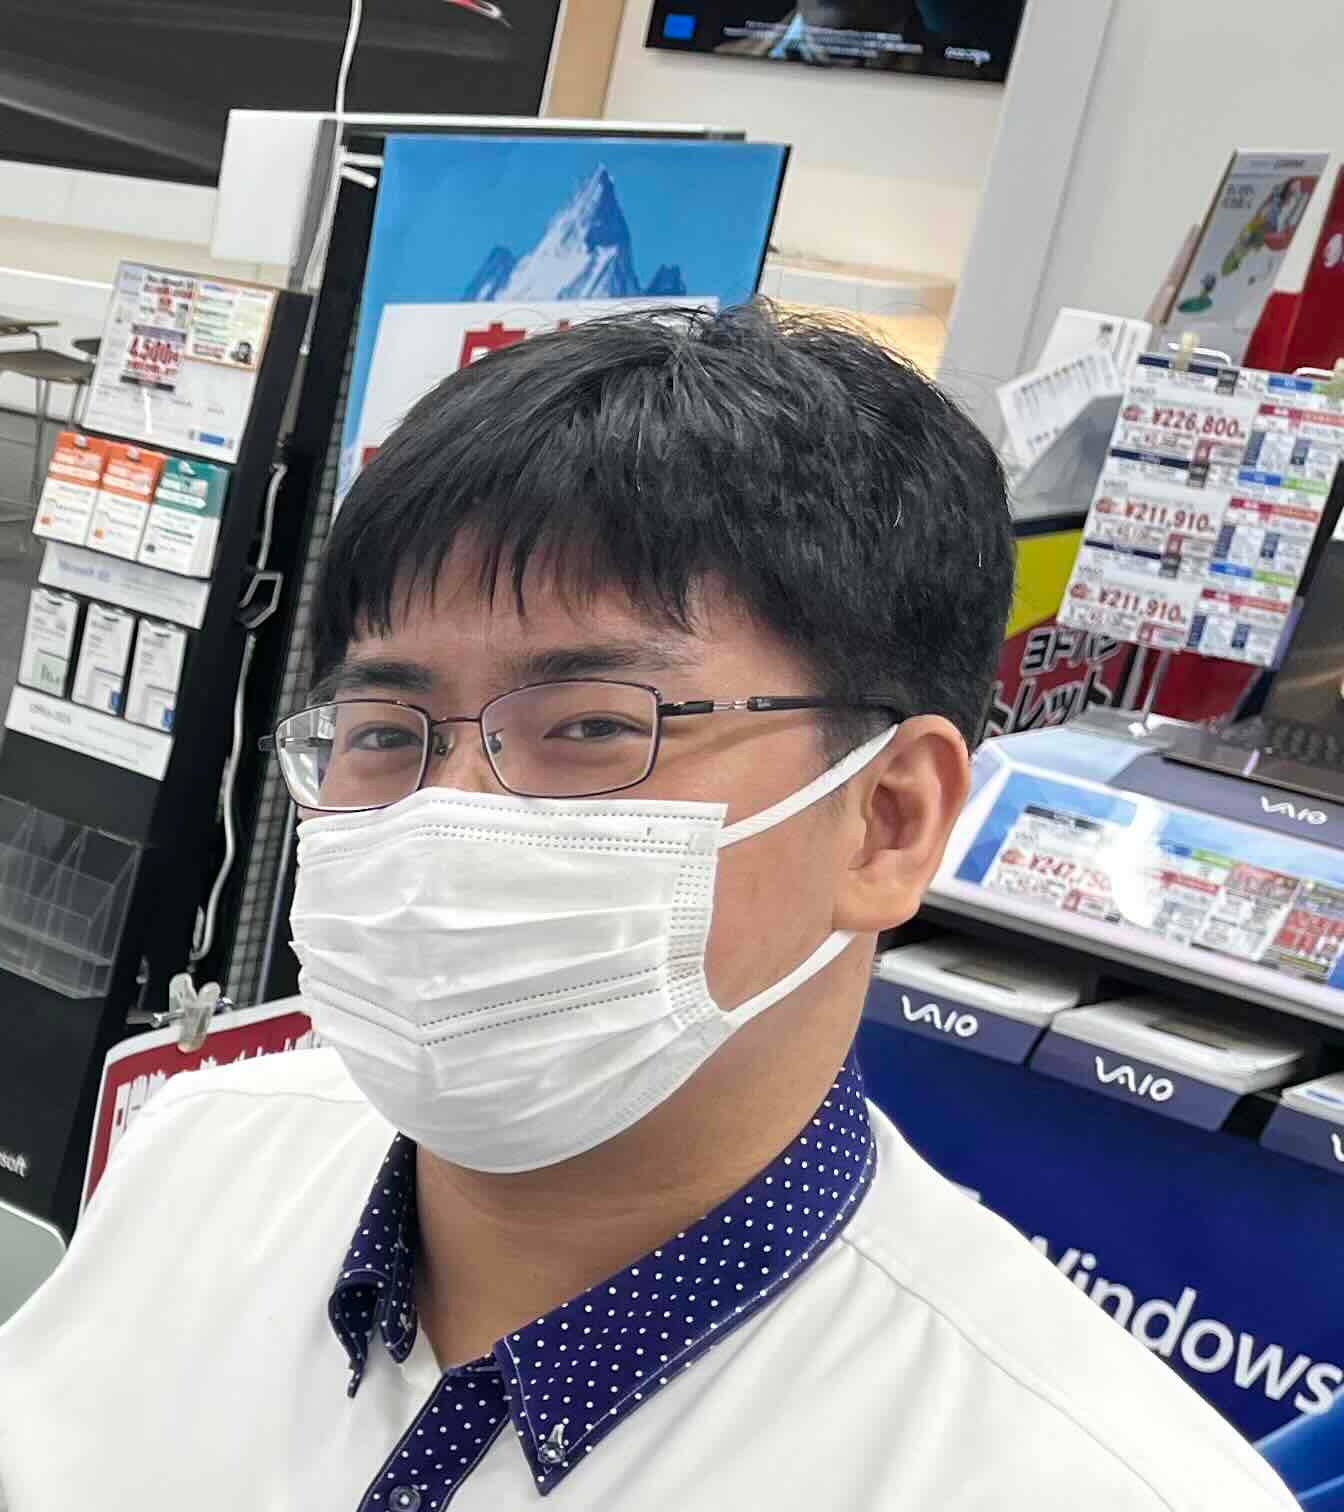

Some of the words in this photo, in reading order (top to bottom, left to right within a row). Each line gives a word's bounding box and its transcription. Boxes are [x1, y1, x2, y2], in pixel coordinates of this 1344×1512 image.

[1262, 796, 1328, 825] VAIO
[902, 995, 978, 1038] VAIO
[1095, 1055, 1174, 1102] VAIO
